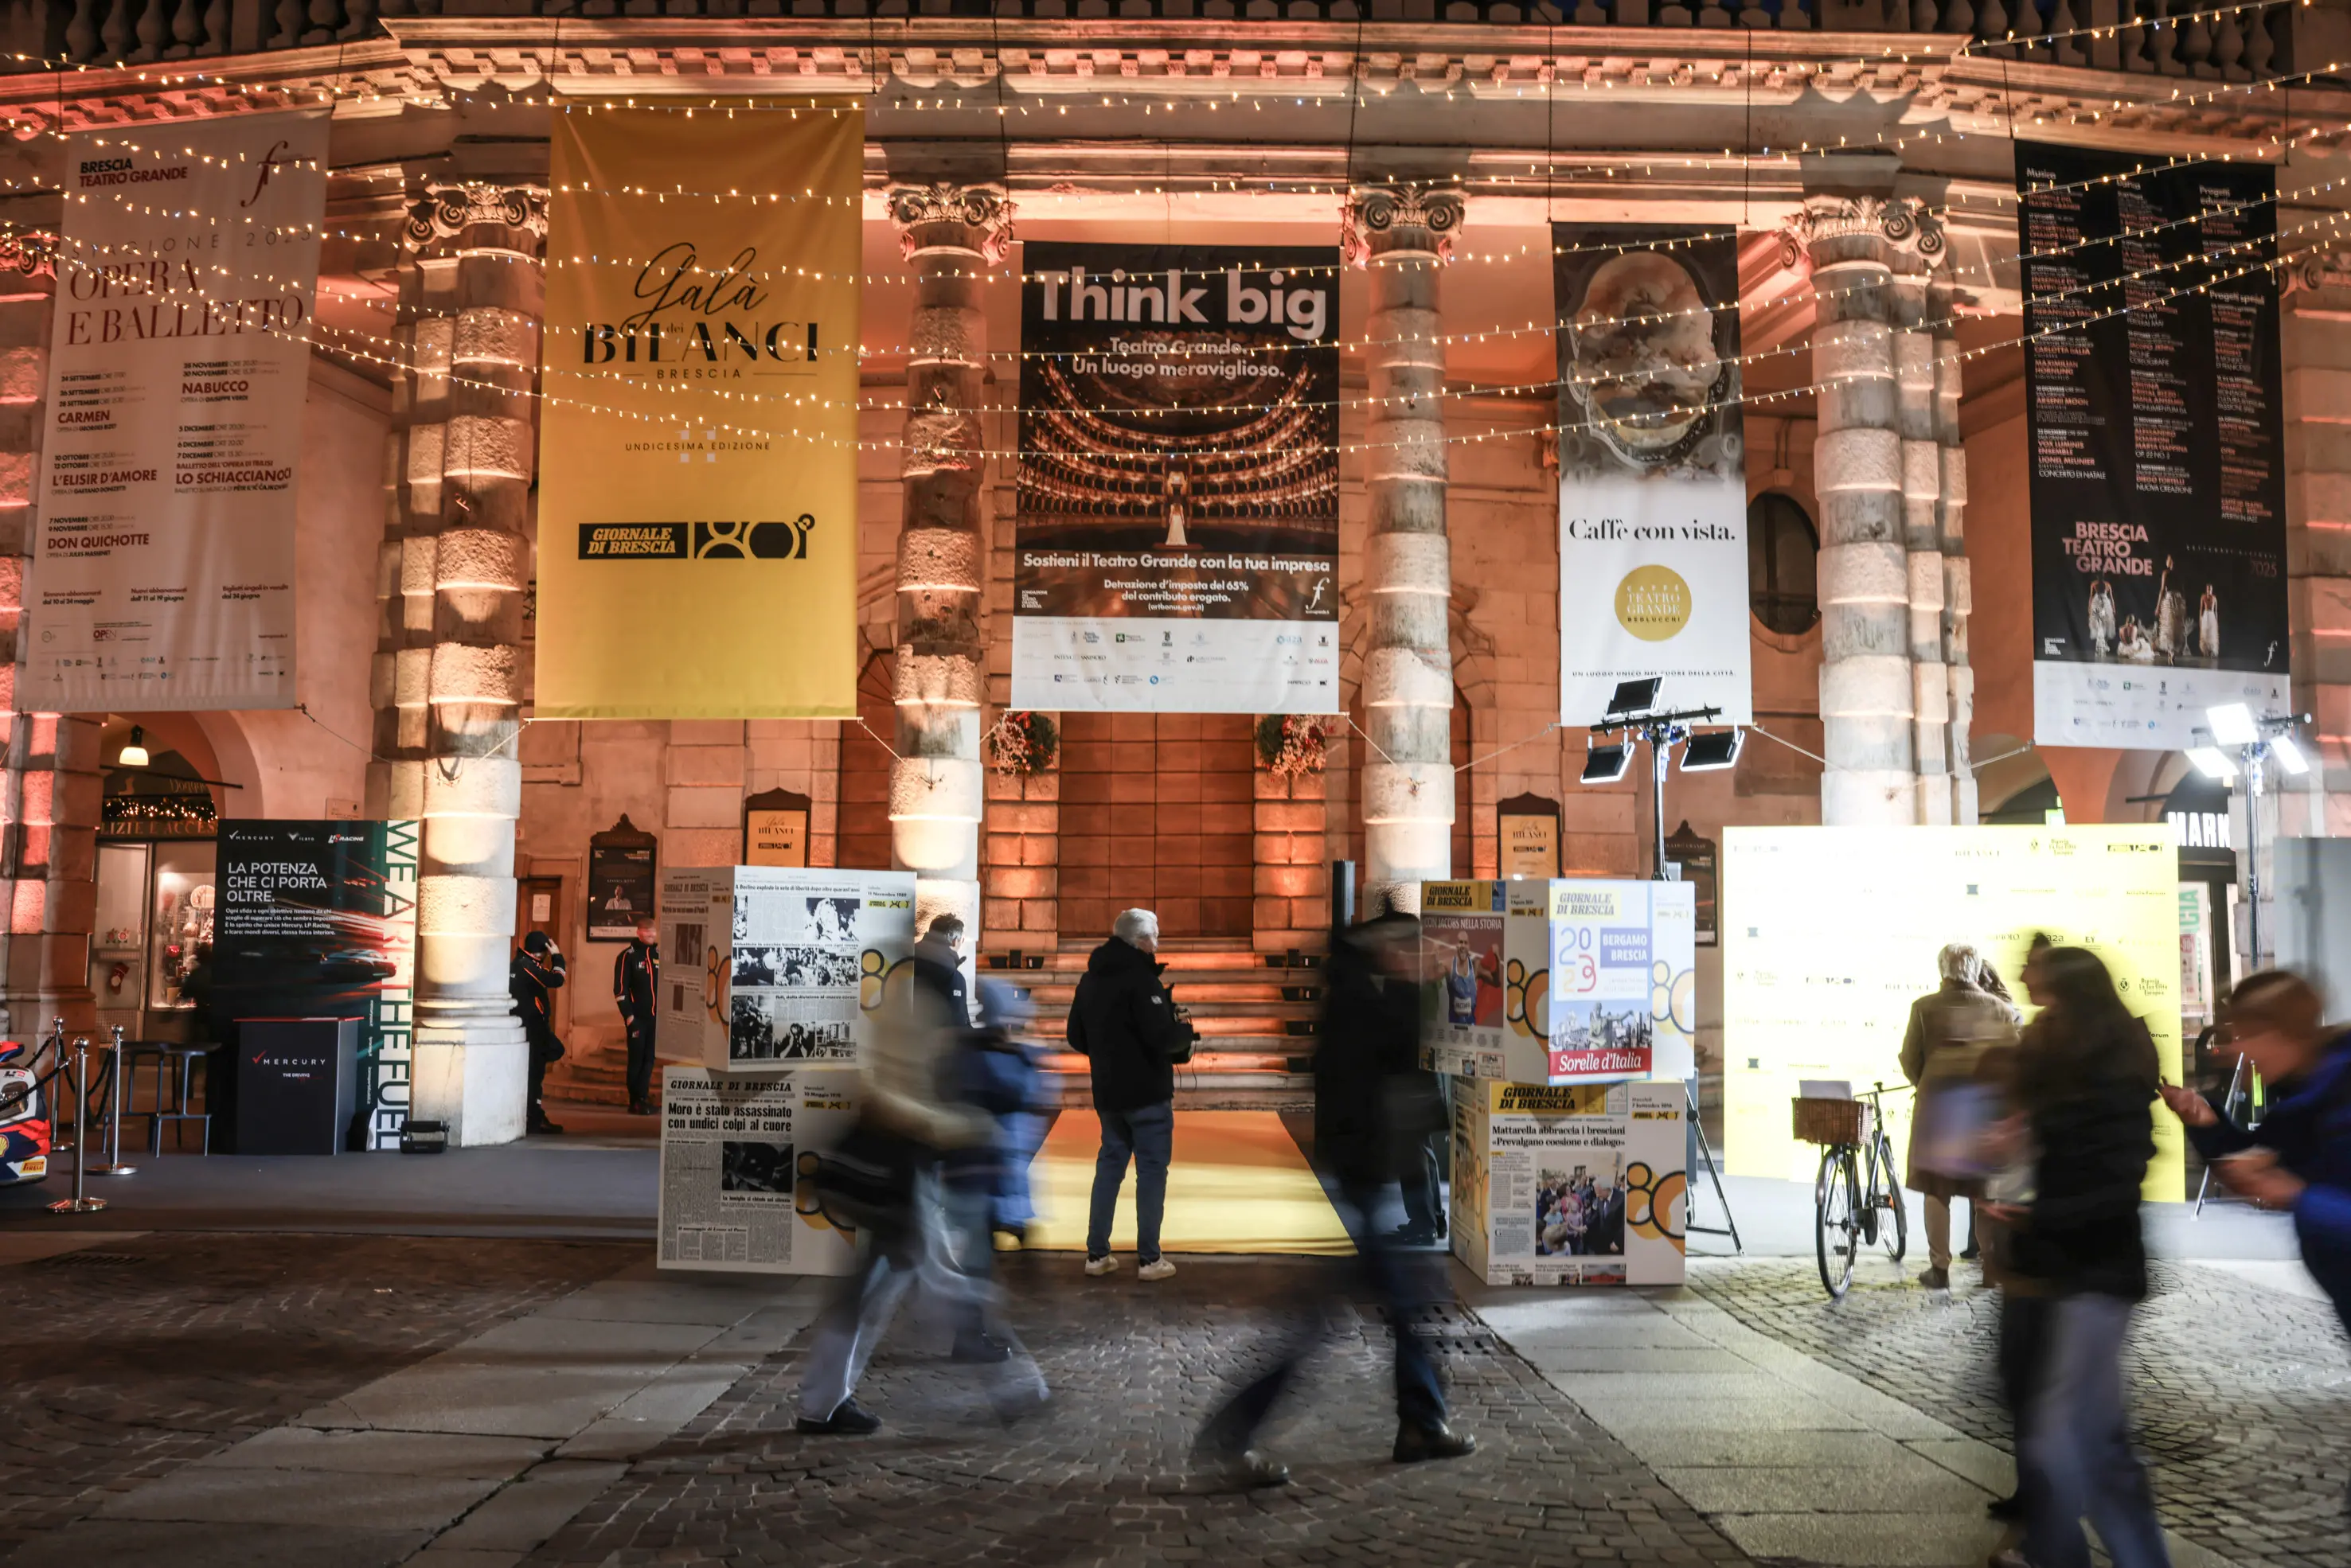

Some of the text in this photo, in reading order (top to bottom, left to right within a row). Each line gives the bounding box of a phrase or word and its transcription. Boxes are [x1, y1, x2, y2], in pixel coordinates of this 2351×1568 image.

[80, 158, 133, 174] BRESCIA
[80, 166, 188, 188] TEATRO GRANDE
[72, 235, 220, 259] STAGIONE
[70, 258, 198, 301] OPERA
[619, 242, 768, 337] Galà
[1034, 266, 1326, 341] Think big
[65, 295, 304, 345] E BALLETTO
[666, 322, 684, 334] dei
[584, 322, 818, 364] BILANCI
[1109, 337, 1167, 353] Teatro
[658, 369, 741, 379] BRESCIA
[1072, 358, 1285, 380] Un luogo meraviglioso.
[182, 380, 248, 393] NABUCCO
[57, 410, 110, 423] CARMEN
[626, 442, 771, 451] UNDICESIMA EDIZIONE
[100, 470, 157, 484] D'AMORE
[176, 467, 291, 485] LO SCHIACCIANOCI
[593, 528, 672, 541] GIORNALE
[1569, 518, 1736, 540] Caffè con vista.
[2076, 521, 2149, 543] BRESCIA
[48, 533, 150, 549] DON QUICHOTTE
[587, 540, 676, 555] DI BRESCIA
[2062, 538, 2131, 557] TEATRO
[1024, 553, 1330, 575] Sostieni il Teatro Grande con la tua impresa
[2076, 557, 2153, 575] GRANDE
[1104, 579, 1249, 594] Detrazione d'imposta del 65%
[1122, 591, 1232, 605] del contributo erogato.
[1627, 592, 1681, 603] TEATRO
[1627, 604, 1681, 614] GRANDE
[228, 862, 318, 875] LA POTENZA
[228, 876, 327, 888] CHE CI PORTA
[227, 890, 275, 903] OLTRE.
[1429, 885, 1471, 896] GIORNALE
[1427, 896, 1472, 907] DI BRESCIA
[1559, 892, 1612, 904] GIORNALE
[1556, 904, 1615, 915] DI BRESCIA
[1438, 918, 1502, 930] JACOBS NELLA STORIA
[1603, 934, 1647, 946] BERGAMO
[1611, 949, 1647, 961] BRESCIA
[1559, 1052, 1642, 1072] Sorelle d'Italia
[670, 1080, 791, 1092] GIORNALE DI BRESCIA
[1503, 1087, 1572, 1098] GIORNALE
[668, 1102, 792, 1117] Moro è stato assassinato
[1499, 1098, 1576, 1110] DI BRESCIA
[668, 1118, 685, 1129] con
[689, 1117, 719, 1130] undici
[723, 1118, 746, 1132] colpi
[750, 1118, 759, 1131] al
[763, 1121, 791, 1132] cuore
[1492, 1125, 1537, 1134] Mattarella
[1538, 1125, 1580, 1135] abbraccia
[1587, 1125, 1625, 1135] bresciani
